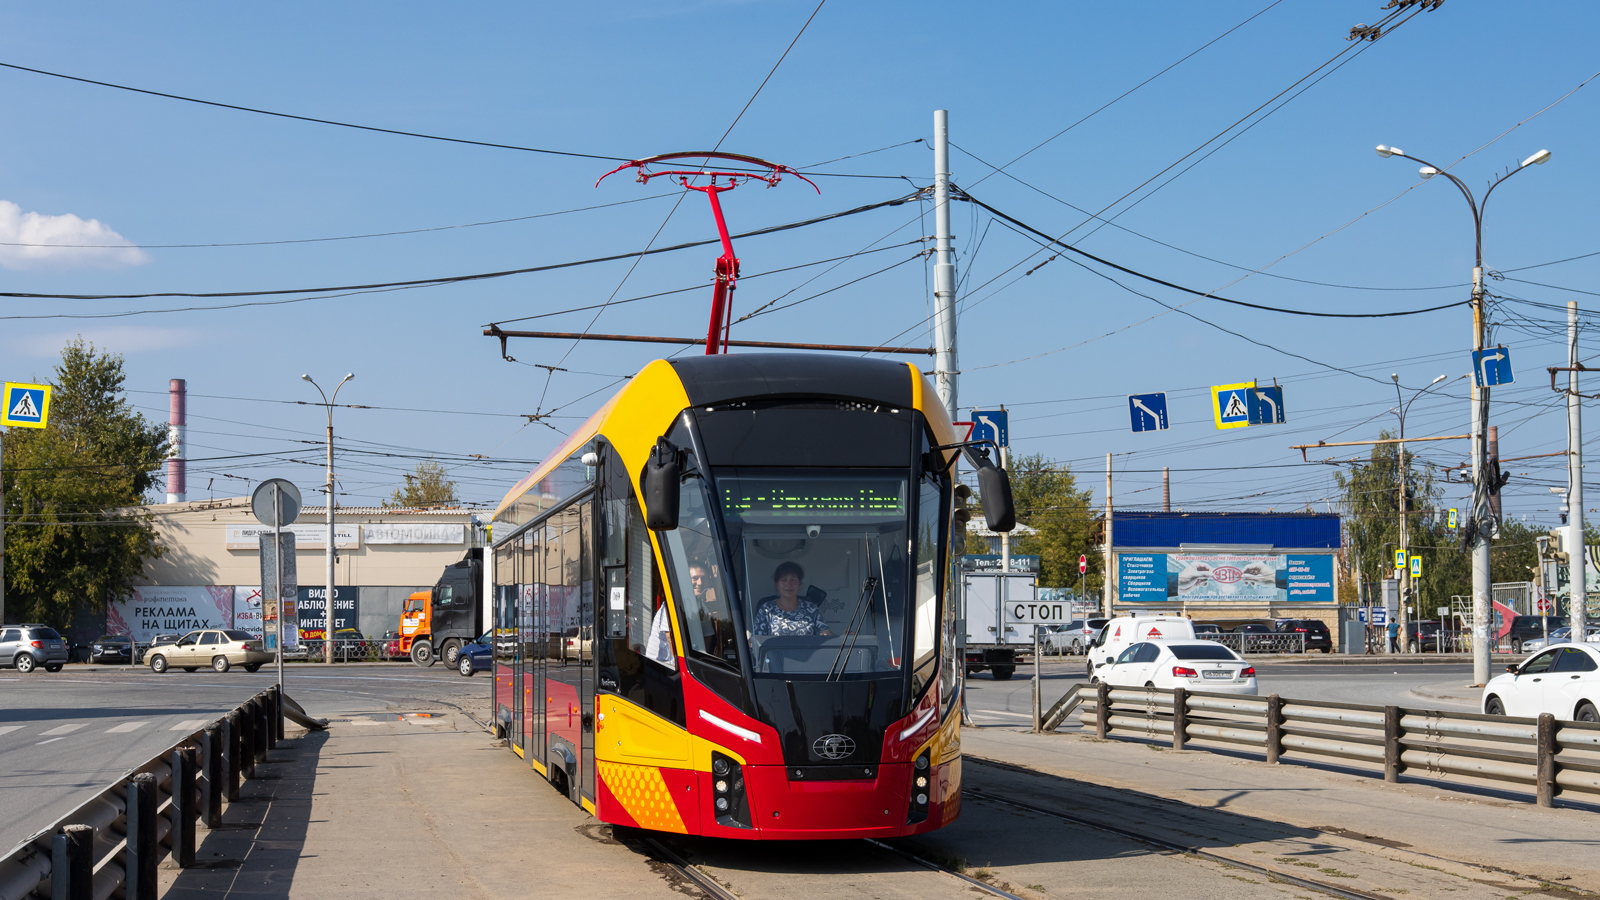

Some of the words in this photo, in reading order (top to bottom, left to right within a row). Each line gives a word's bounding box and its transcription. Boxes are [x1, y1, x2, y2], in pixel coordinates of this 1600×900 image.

[366, 526, 449, 540] АВТОМОЙКА
[1214, 569, 1239, 581] УЗТМ
[308, 589, 338, 599] ВИДО
[135, 607, 196, 617] РЕКЛАМА
[1014, 604, 1062, 619] СТОП
[142, 620, 159, 629] НА
[164, 620, 209, 631] ЩИТАХ
[300, 619, 345, 628] ИНТЕРЕТ
